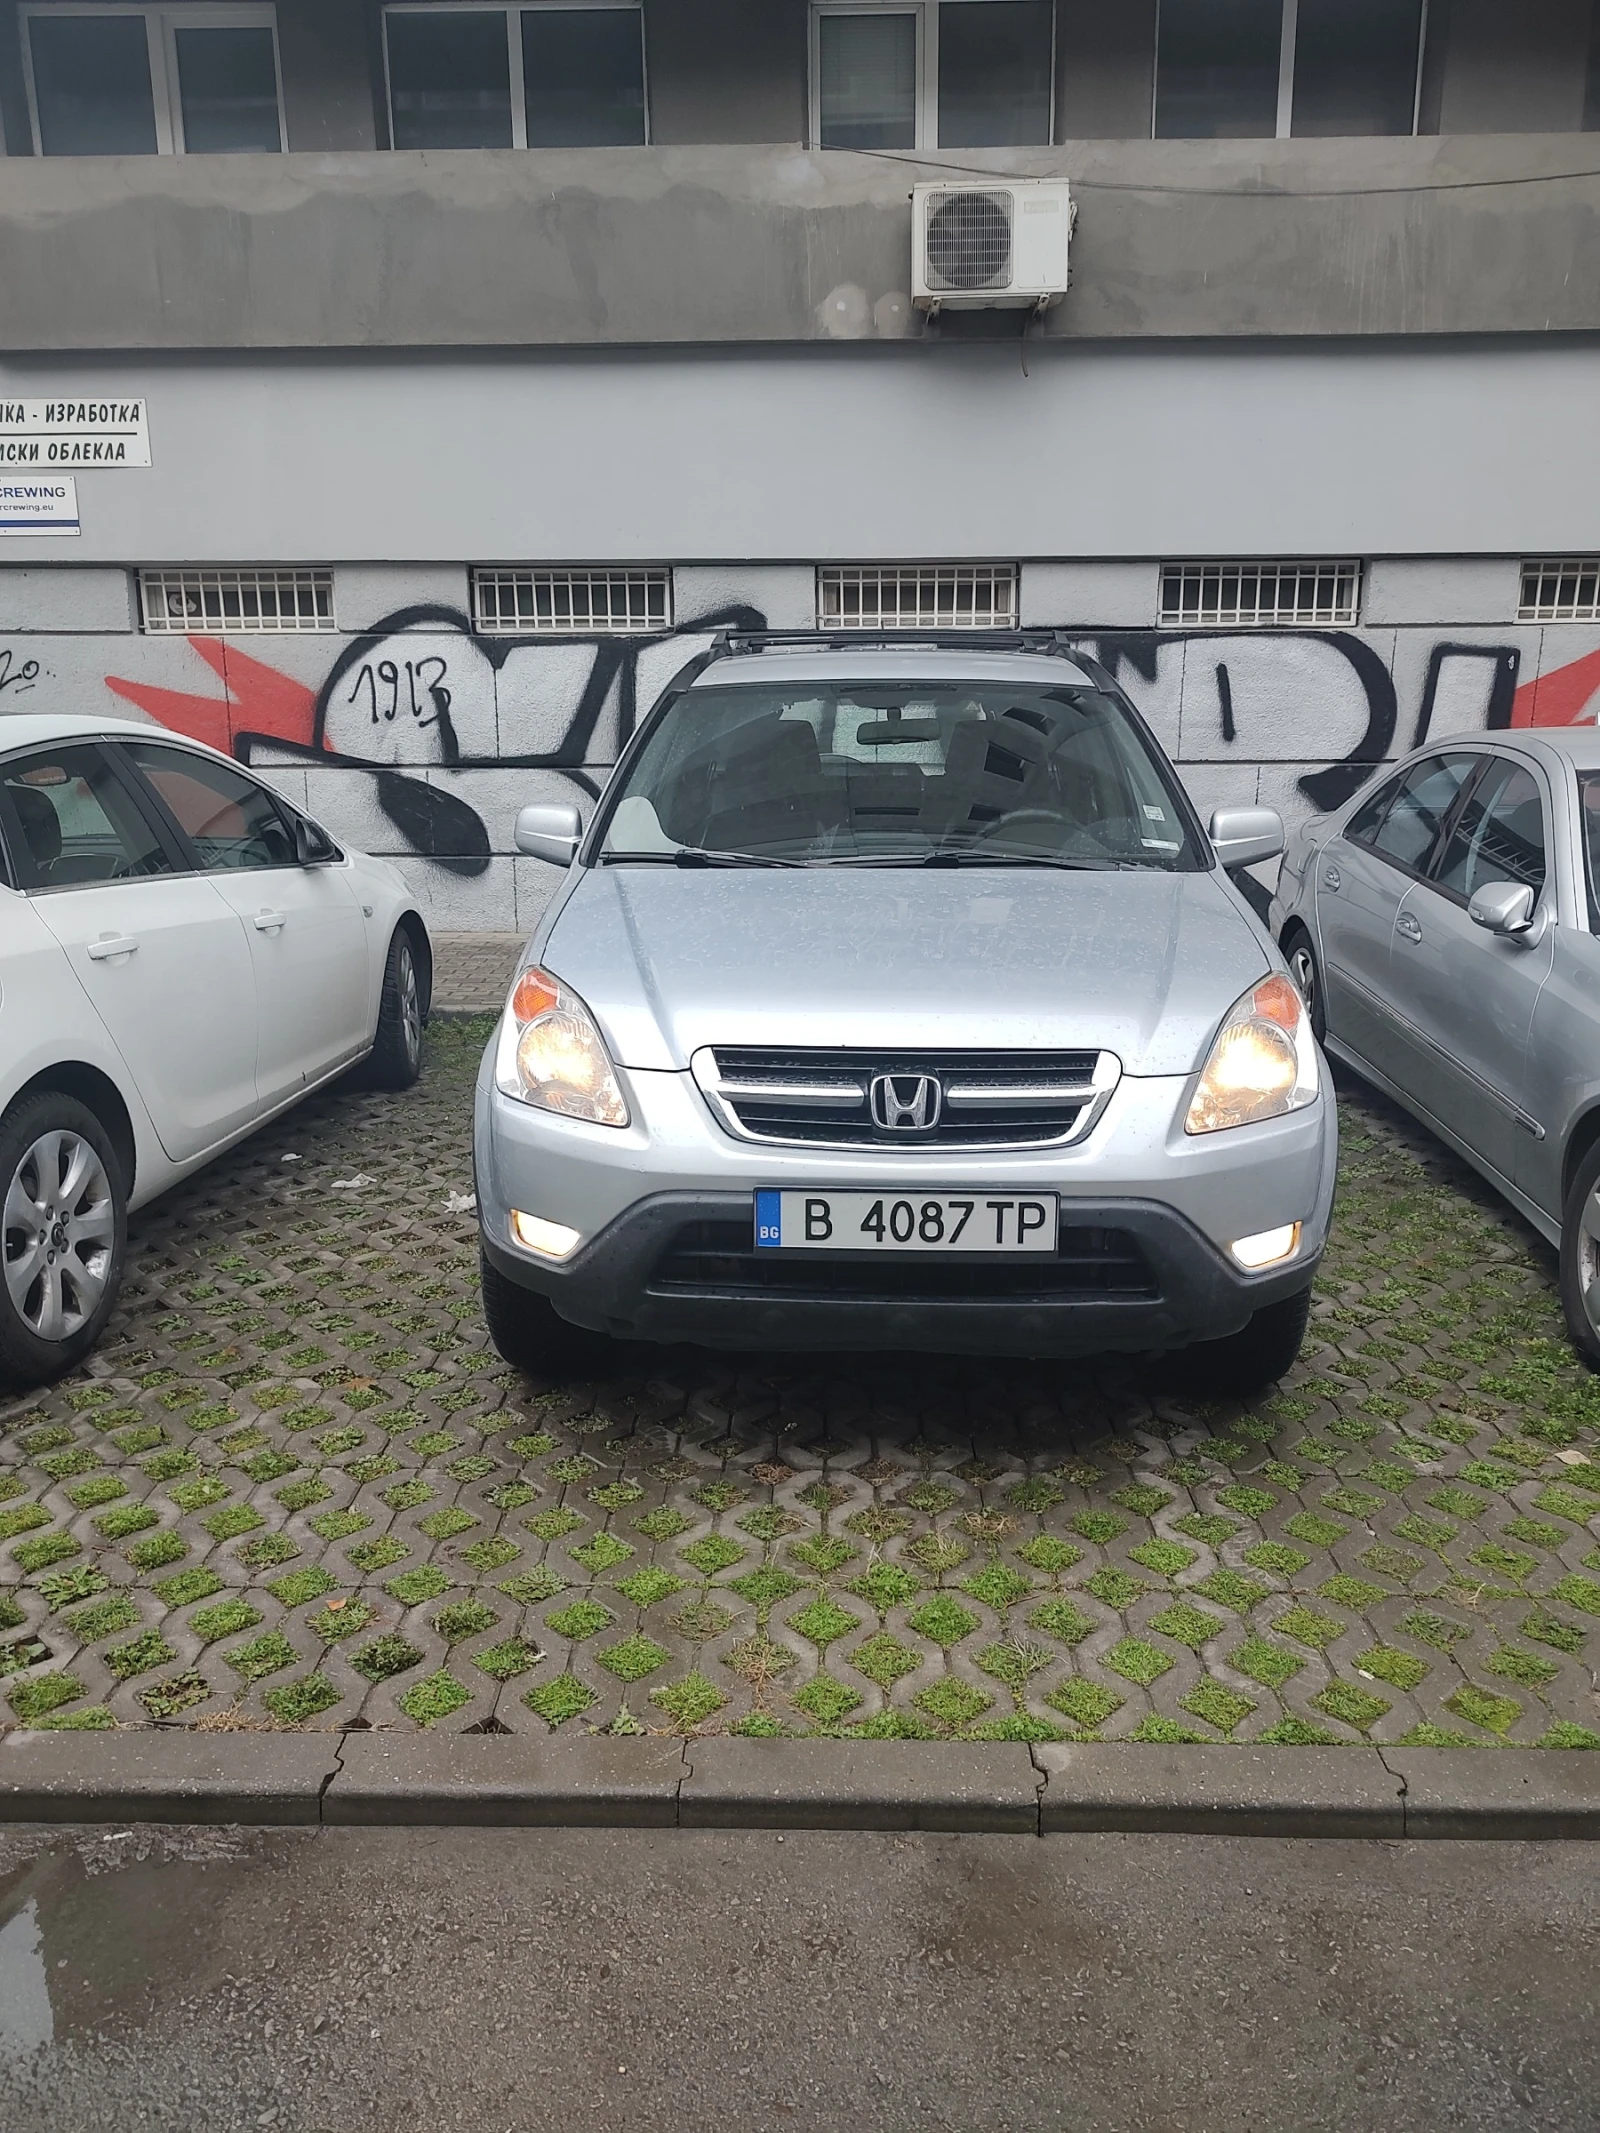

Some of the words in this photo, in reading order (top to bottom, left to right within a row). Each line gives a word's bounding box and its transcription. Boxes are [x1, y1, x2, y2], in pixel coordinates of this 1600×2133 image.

[45, 403, 140, 423] ИЗРАБОТКА
[47, 442, 126, 461] ОБЛЕКЛА
[348, 656, 452, 728] 1913
[804, 1198, 833, 1241] B
[860, 1199, 975, 1243] 4087
[986, 1201, 1046, 1244] TP
[759, 1226, 780, 1239] BG
